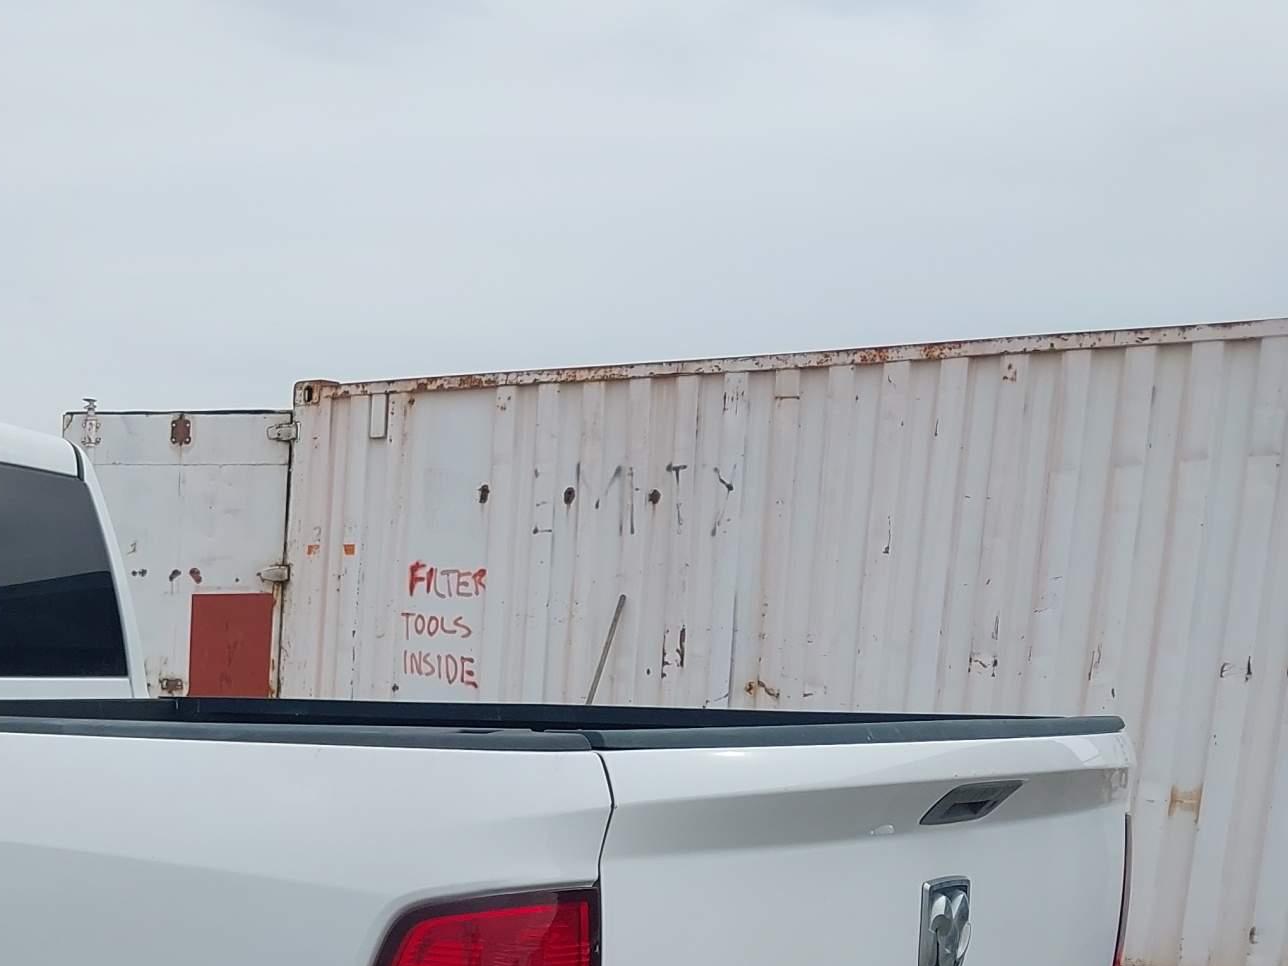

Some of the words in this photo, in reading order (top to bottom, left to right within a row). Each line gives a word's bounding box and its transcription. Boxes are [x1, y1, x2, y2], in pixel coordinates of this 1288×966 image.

[409, 561, 487, 599] FILTER
[400, 612, 472, 640] TOOLS
[403, 649, 478, 689] INSIDE
